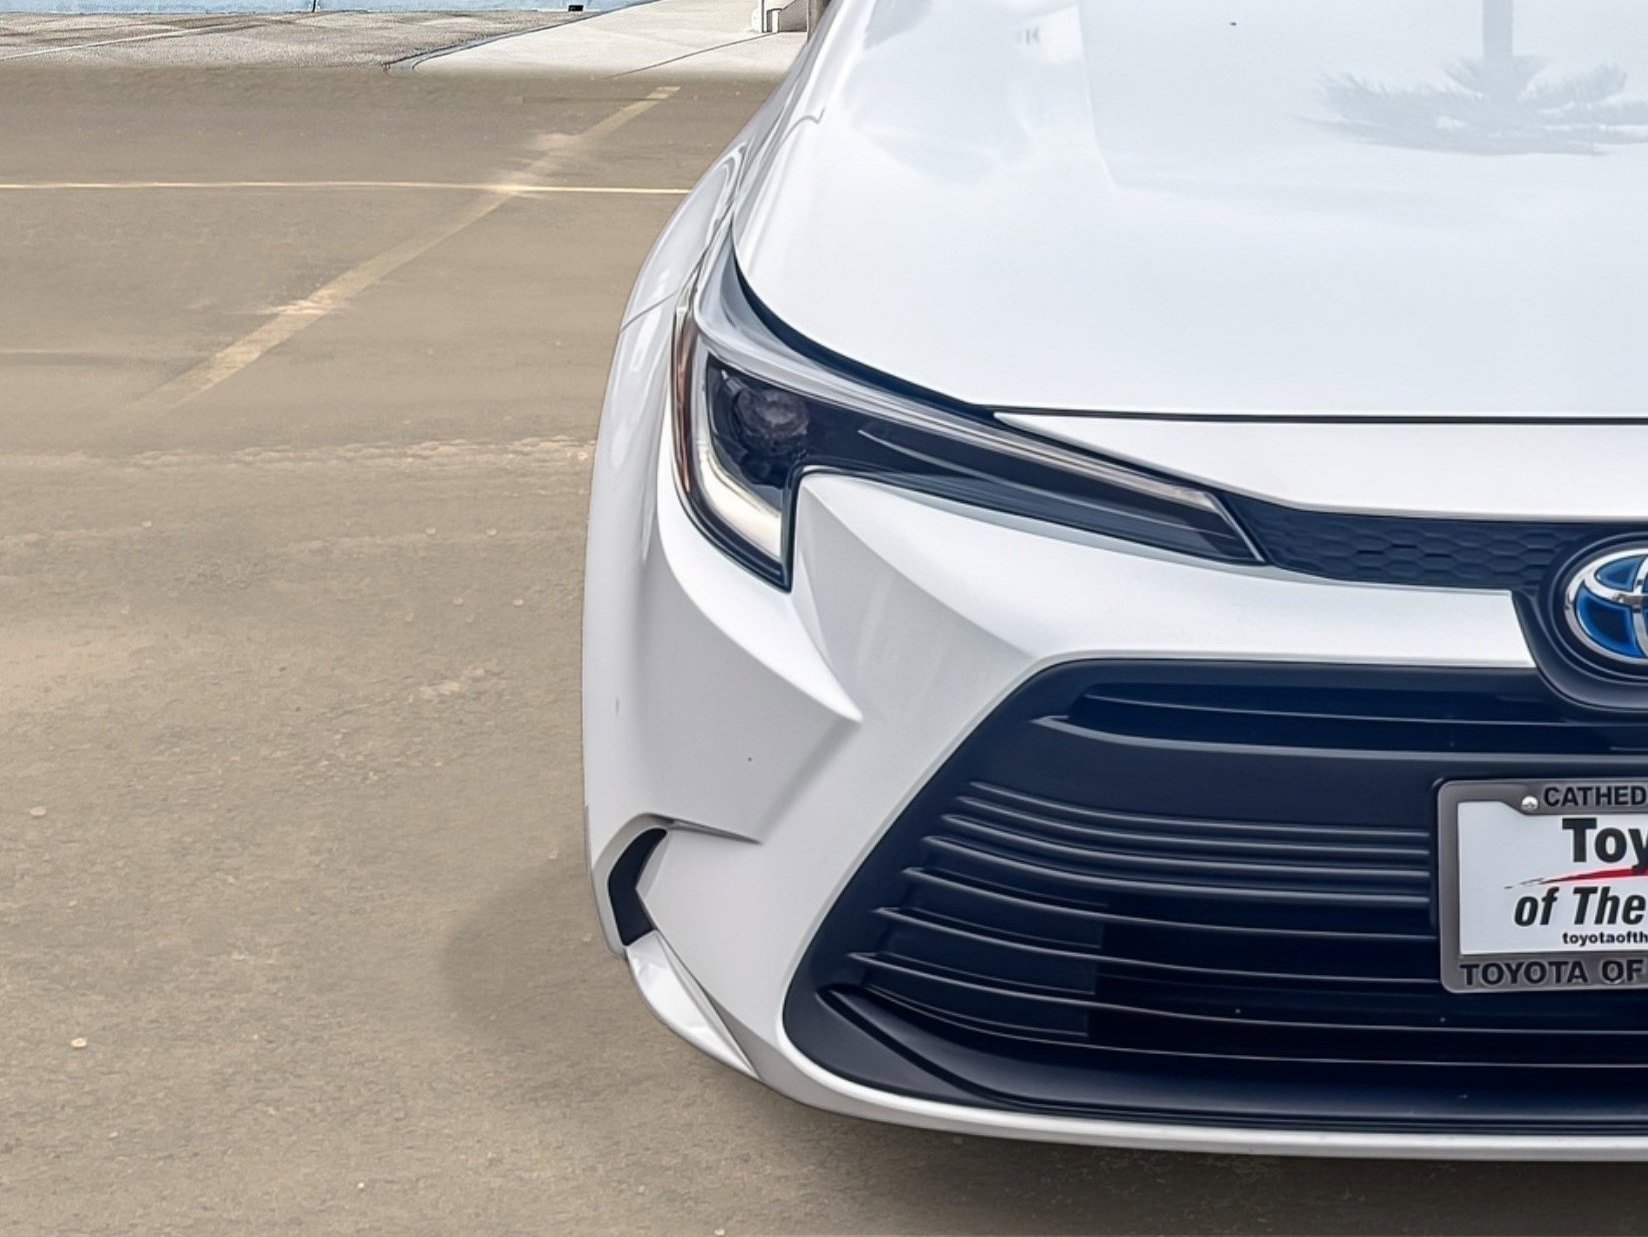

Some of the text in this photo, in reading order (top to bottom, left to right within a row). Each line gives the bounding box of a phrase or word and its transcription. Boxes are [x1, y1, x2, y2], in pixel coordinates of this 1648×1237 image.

[1513, 886, 1560, 927] of
[1574, 886, 1647, 925] The
[1460, 961, 1588, 986] TOYOTA
[1601, 960, 1643, 984] OF
